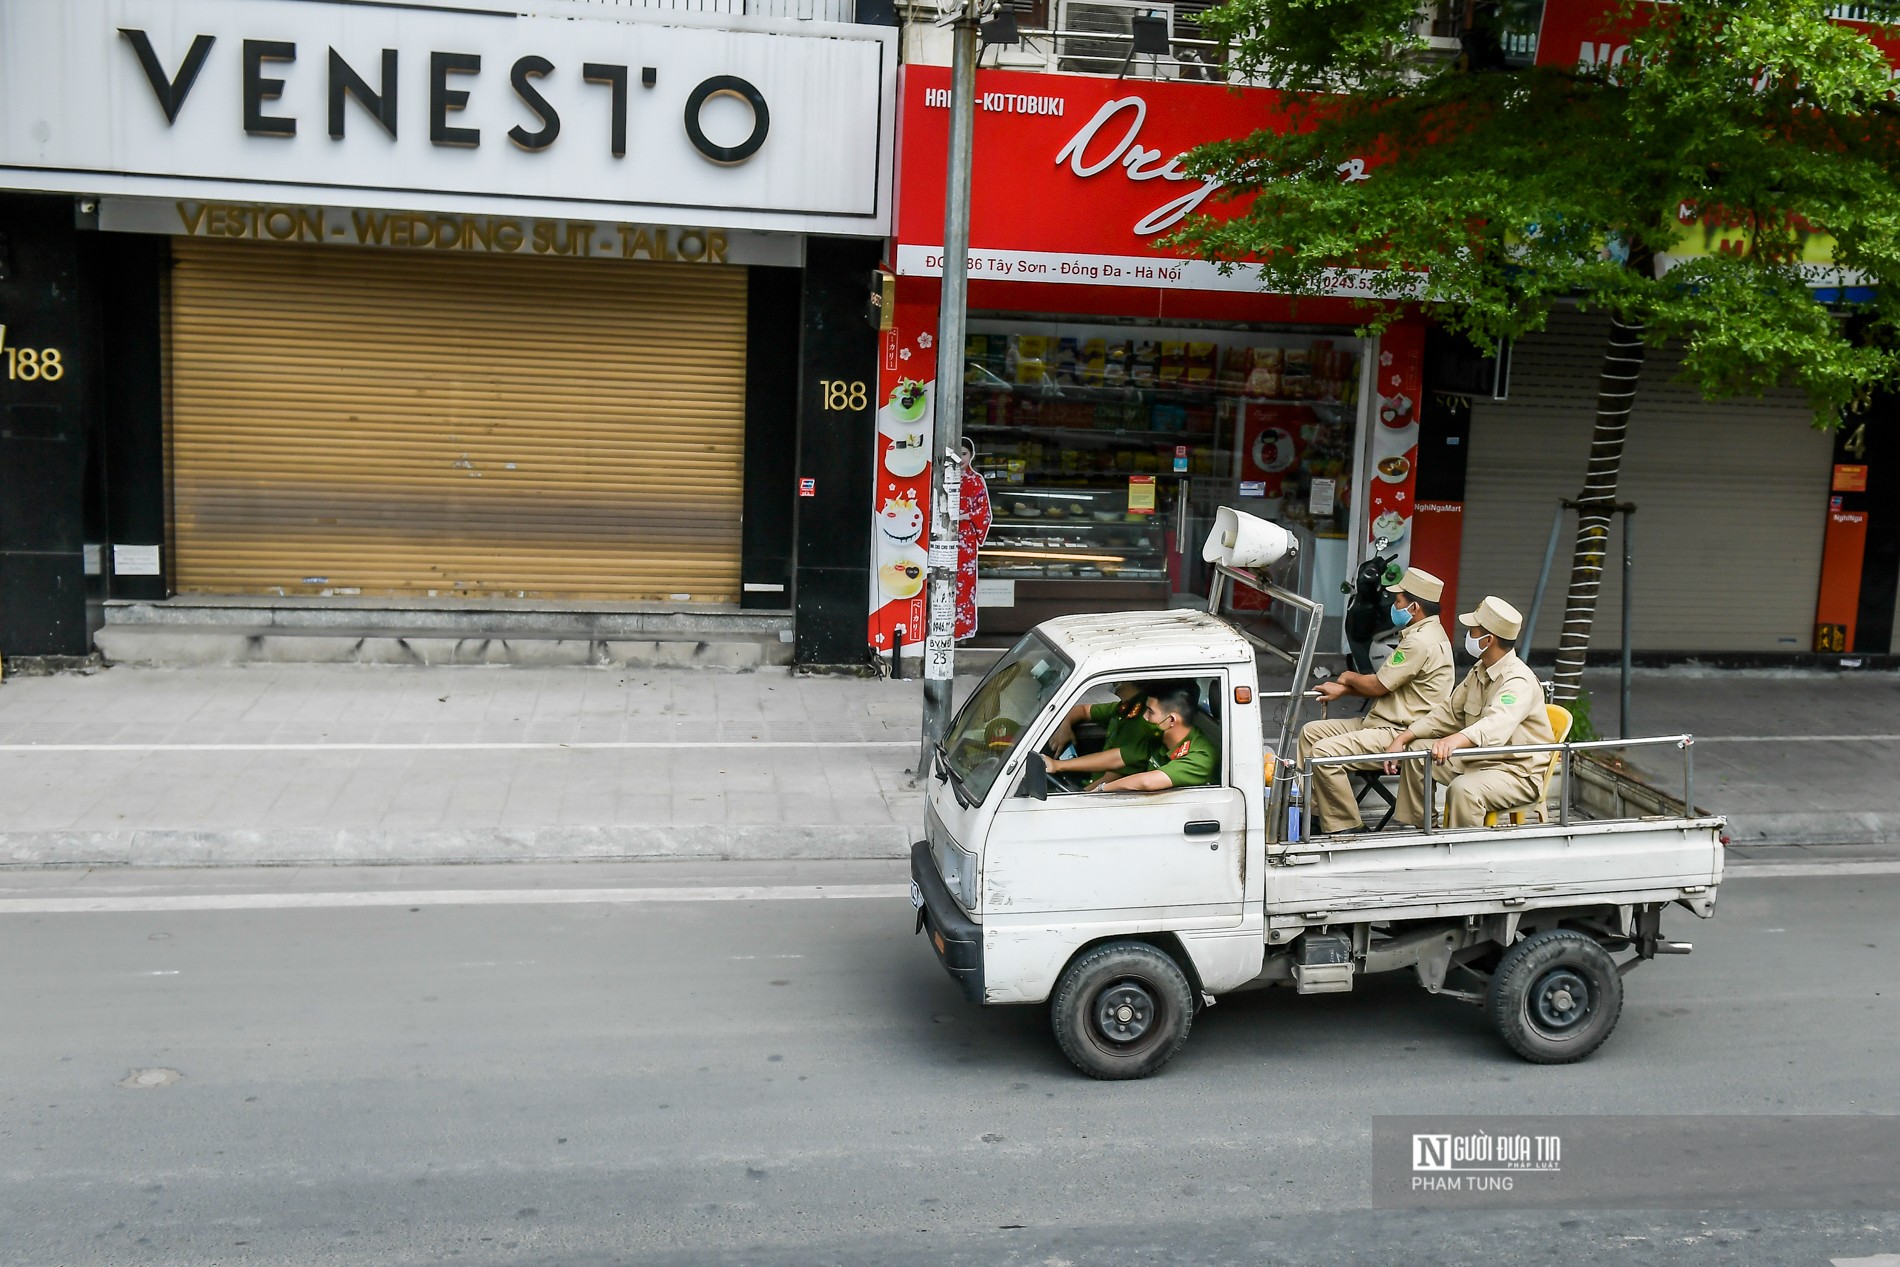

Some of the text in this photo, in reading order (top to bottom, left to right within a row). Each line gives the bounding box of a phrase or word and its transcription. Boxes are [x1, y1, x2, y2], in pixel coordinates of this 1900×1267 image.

[117, 28, 770, 167] VENESTO
[176, 202, 324, 242] VESTON
[352, 211, 525, 253] WEDDING
[533, 221, 596, 257] SUIT
[617, 227, 729, 263] TAILOR
[988, 259, 1013, 274] Tây
[1018, 260, 1047, 274] Sơn
[1061, 260, 1098, 279] Đống
[1103, 264, 1121, 277] Đa
[1135, 266, 1153, 279] Hà
[1158, 267, 1181, 283] Nội
[4, 347, 64, 382] 188
[820, 380, 867, 411] 188
[1414, 502, 1461, 513] NghiNgaMart
[933, 652, 947, 665] 23
